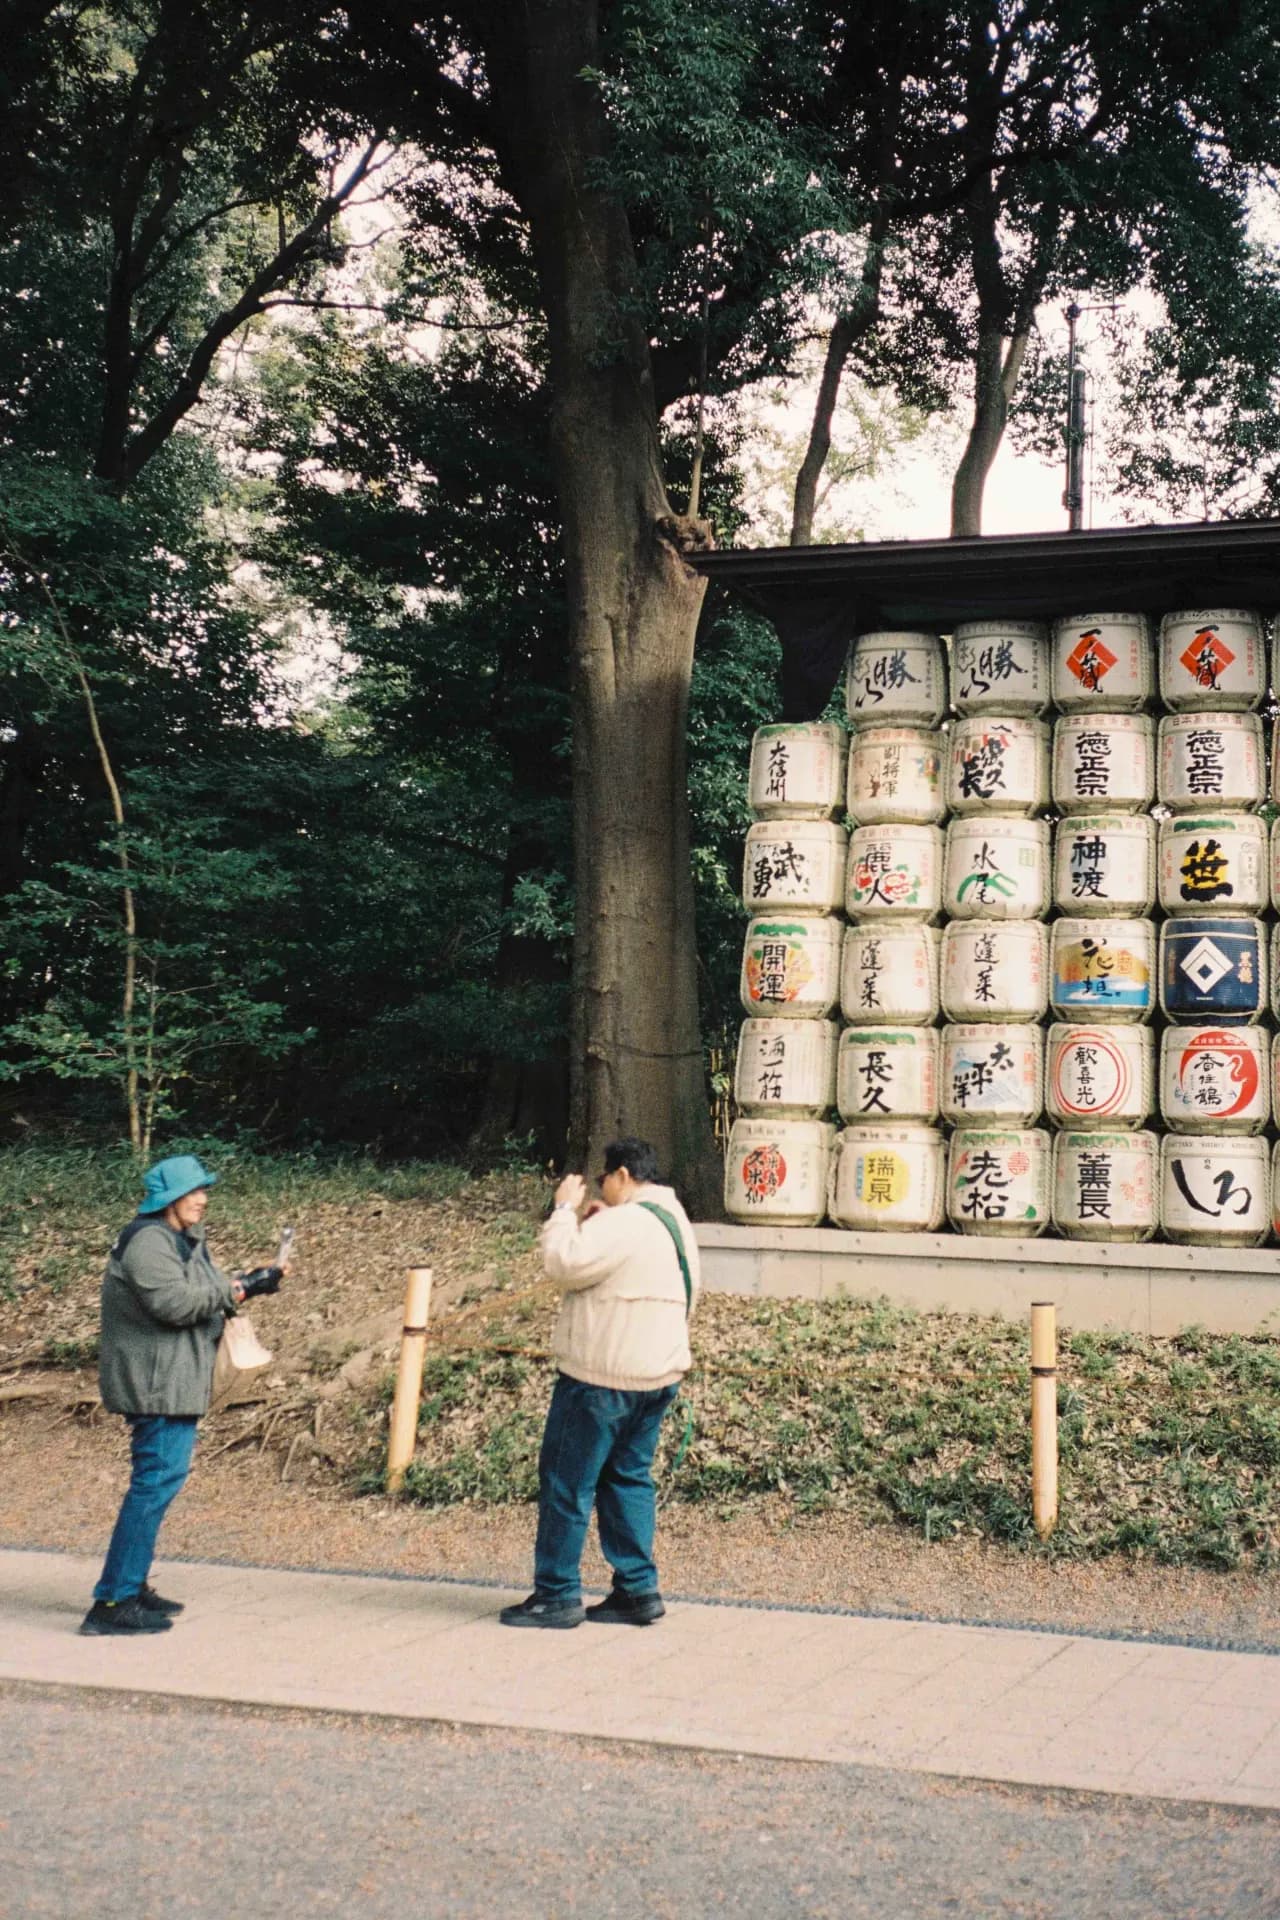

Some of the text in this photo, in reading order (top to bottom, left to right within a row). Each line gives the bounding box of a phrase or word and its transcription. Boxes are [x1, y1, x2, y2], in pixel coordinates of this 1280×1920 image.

[766, 741, 790, 801] 大信州
[882, 744, 901, 799] 副将軍
[1074, 731, 1112, 796] 徳正宗
[1186, 730, 1225, 794] 徳正宗
[753, 841, 805, 898] 武勇
[865, 843, 894, 905] 麗人
[968, 841, 1000, 905] 水尾
[1071, 835, 1108, 898] 神渡
[759, 944, 787, 1003] 開運
[859, 1052, 893, 1113] 長久
[745, 1149, 764, 1204] 久米仙
[867, 1156, 895, 1204] 瑞泉
[962, 1150, 1009, 1220] 老松
[1171, 1159, 1251, 1217] しろ
